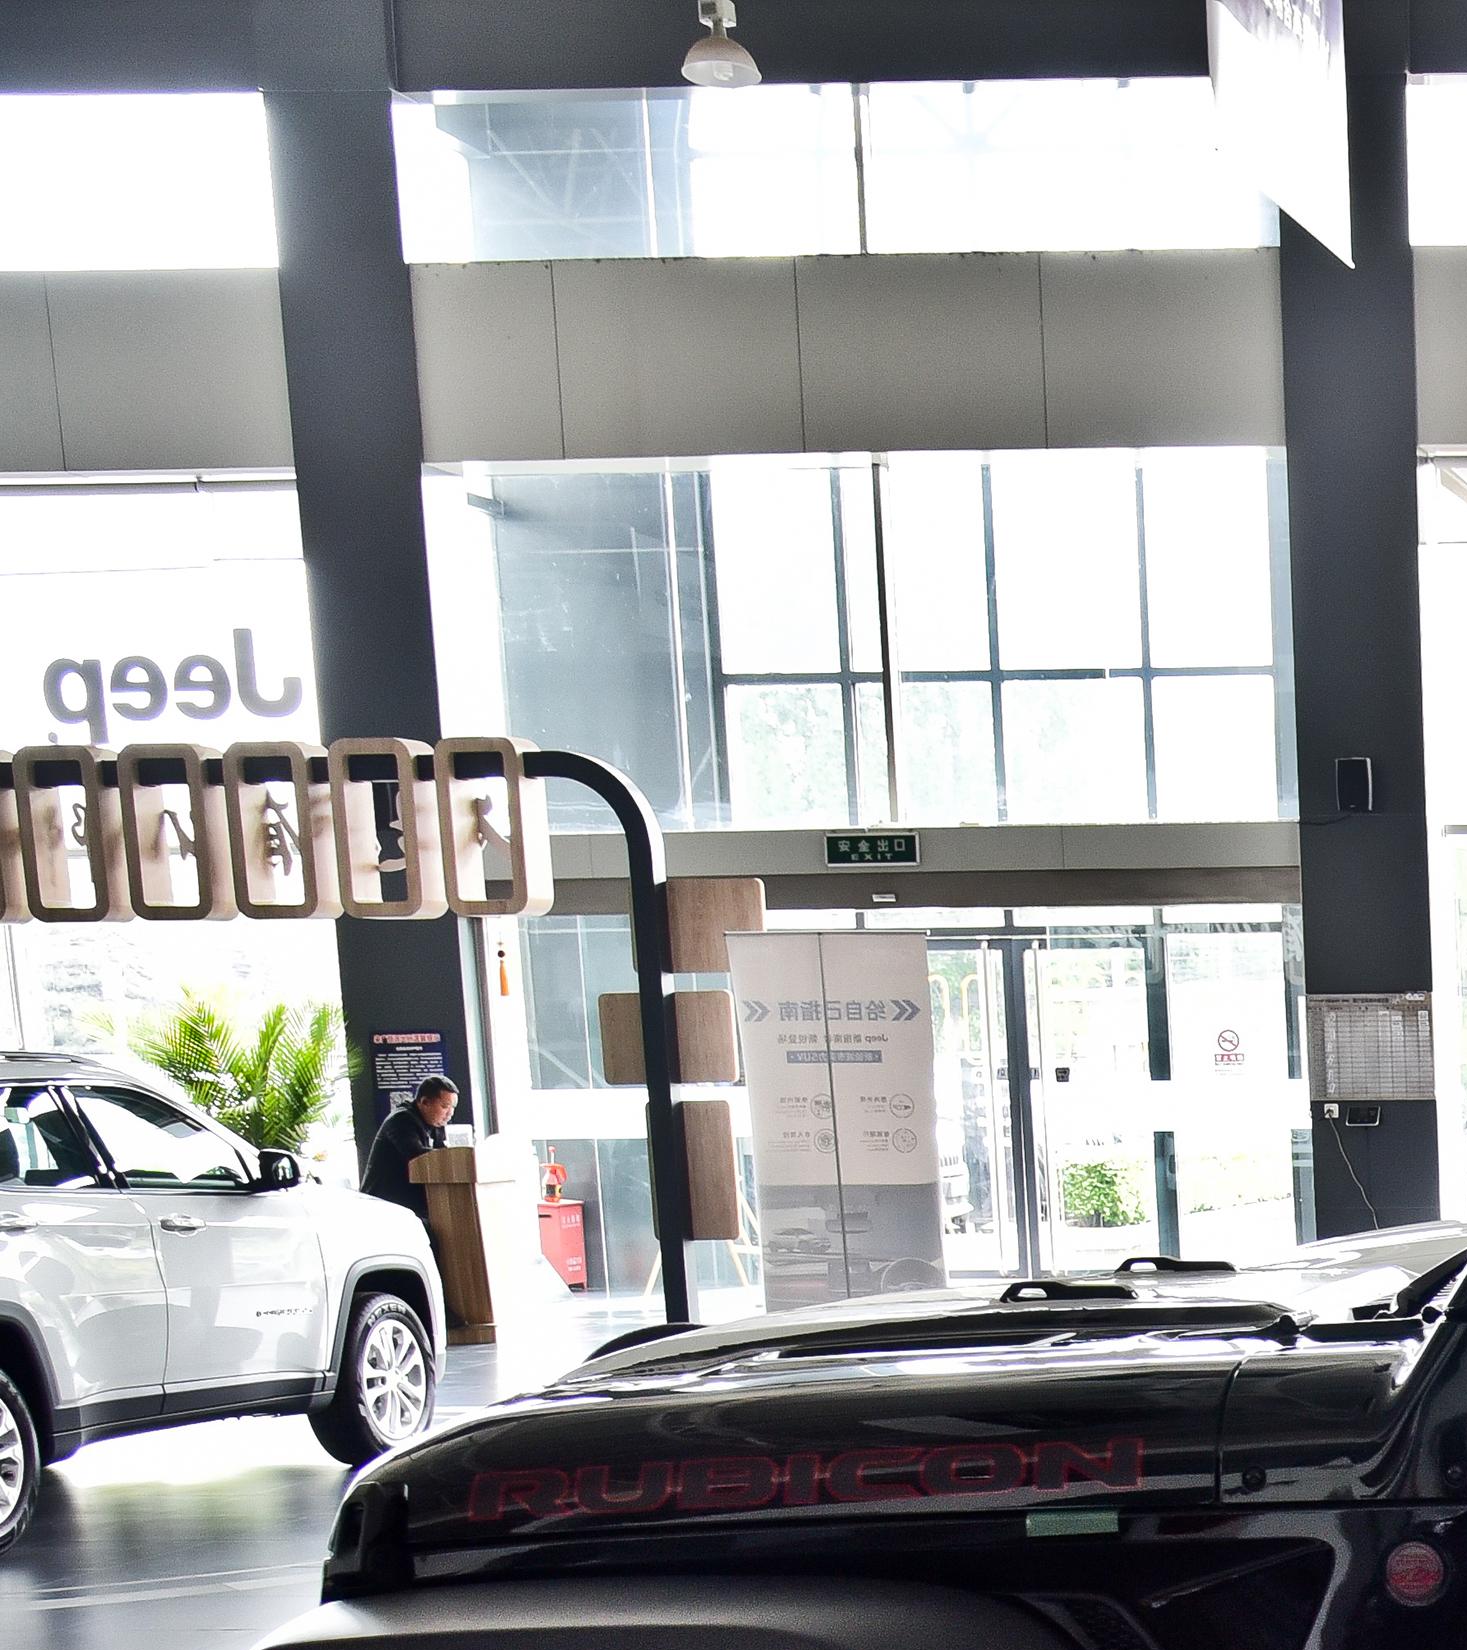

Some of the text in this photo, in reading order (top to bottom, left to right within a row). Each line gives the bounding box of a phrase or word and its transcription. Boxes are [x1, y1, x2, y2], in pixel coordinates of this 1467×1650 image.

[838, 839, 906, 851] 安全出口
[467, 1437, 1147, 1521] RUBICON
